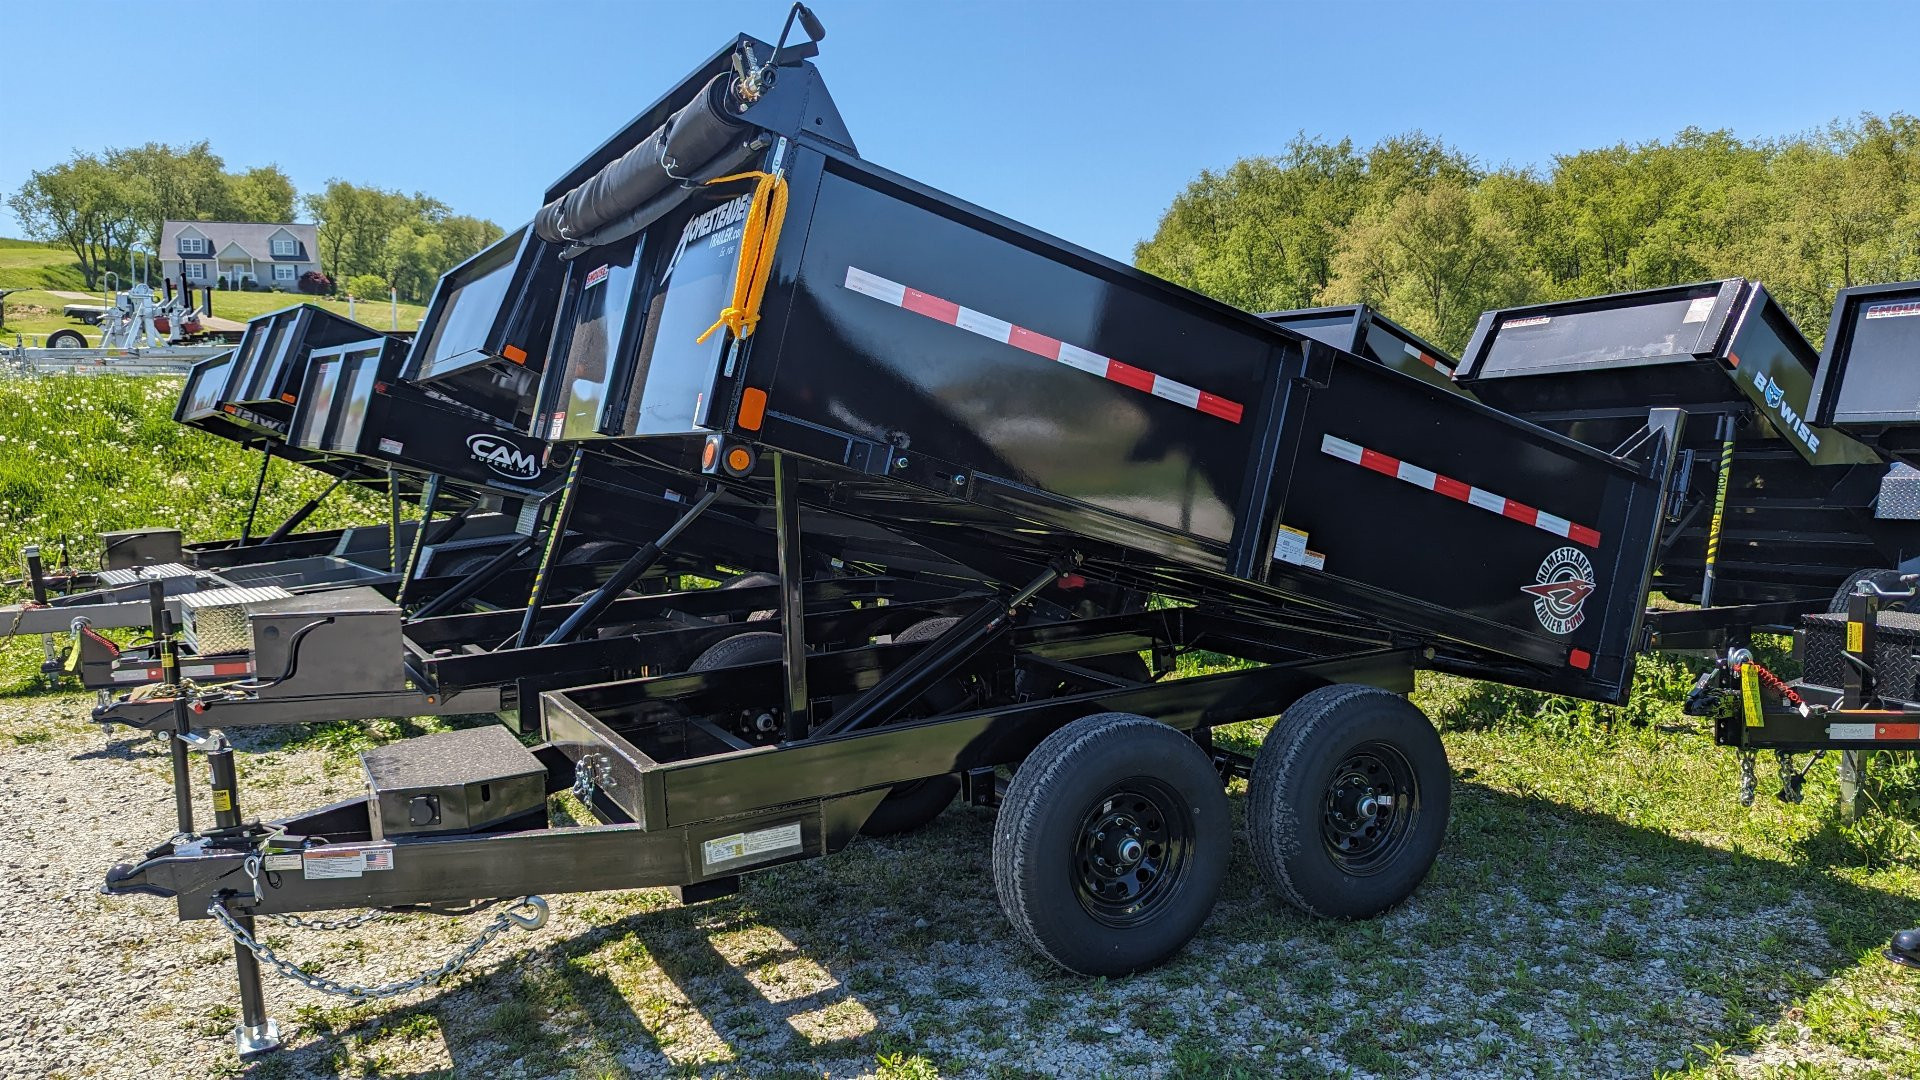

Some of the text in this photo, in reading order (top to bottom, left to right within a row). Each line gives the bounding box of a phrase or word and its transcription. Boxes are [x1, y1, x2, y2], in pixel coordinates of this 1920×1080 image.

[470, 454, 535, 476] SUPERLINE
[472, 440, 535, 471] CAM
[1711, 471, 1728, 533] SAFETY PROP
[1537, 548, 1594, 584] HOMESTEADER
[1535, 600, 1585, 633] TRAILER.COM
